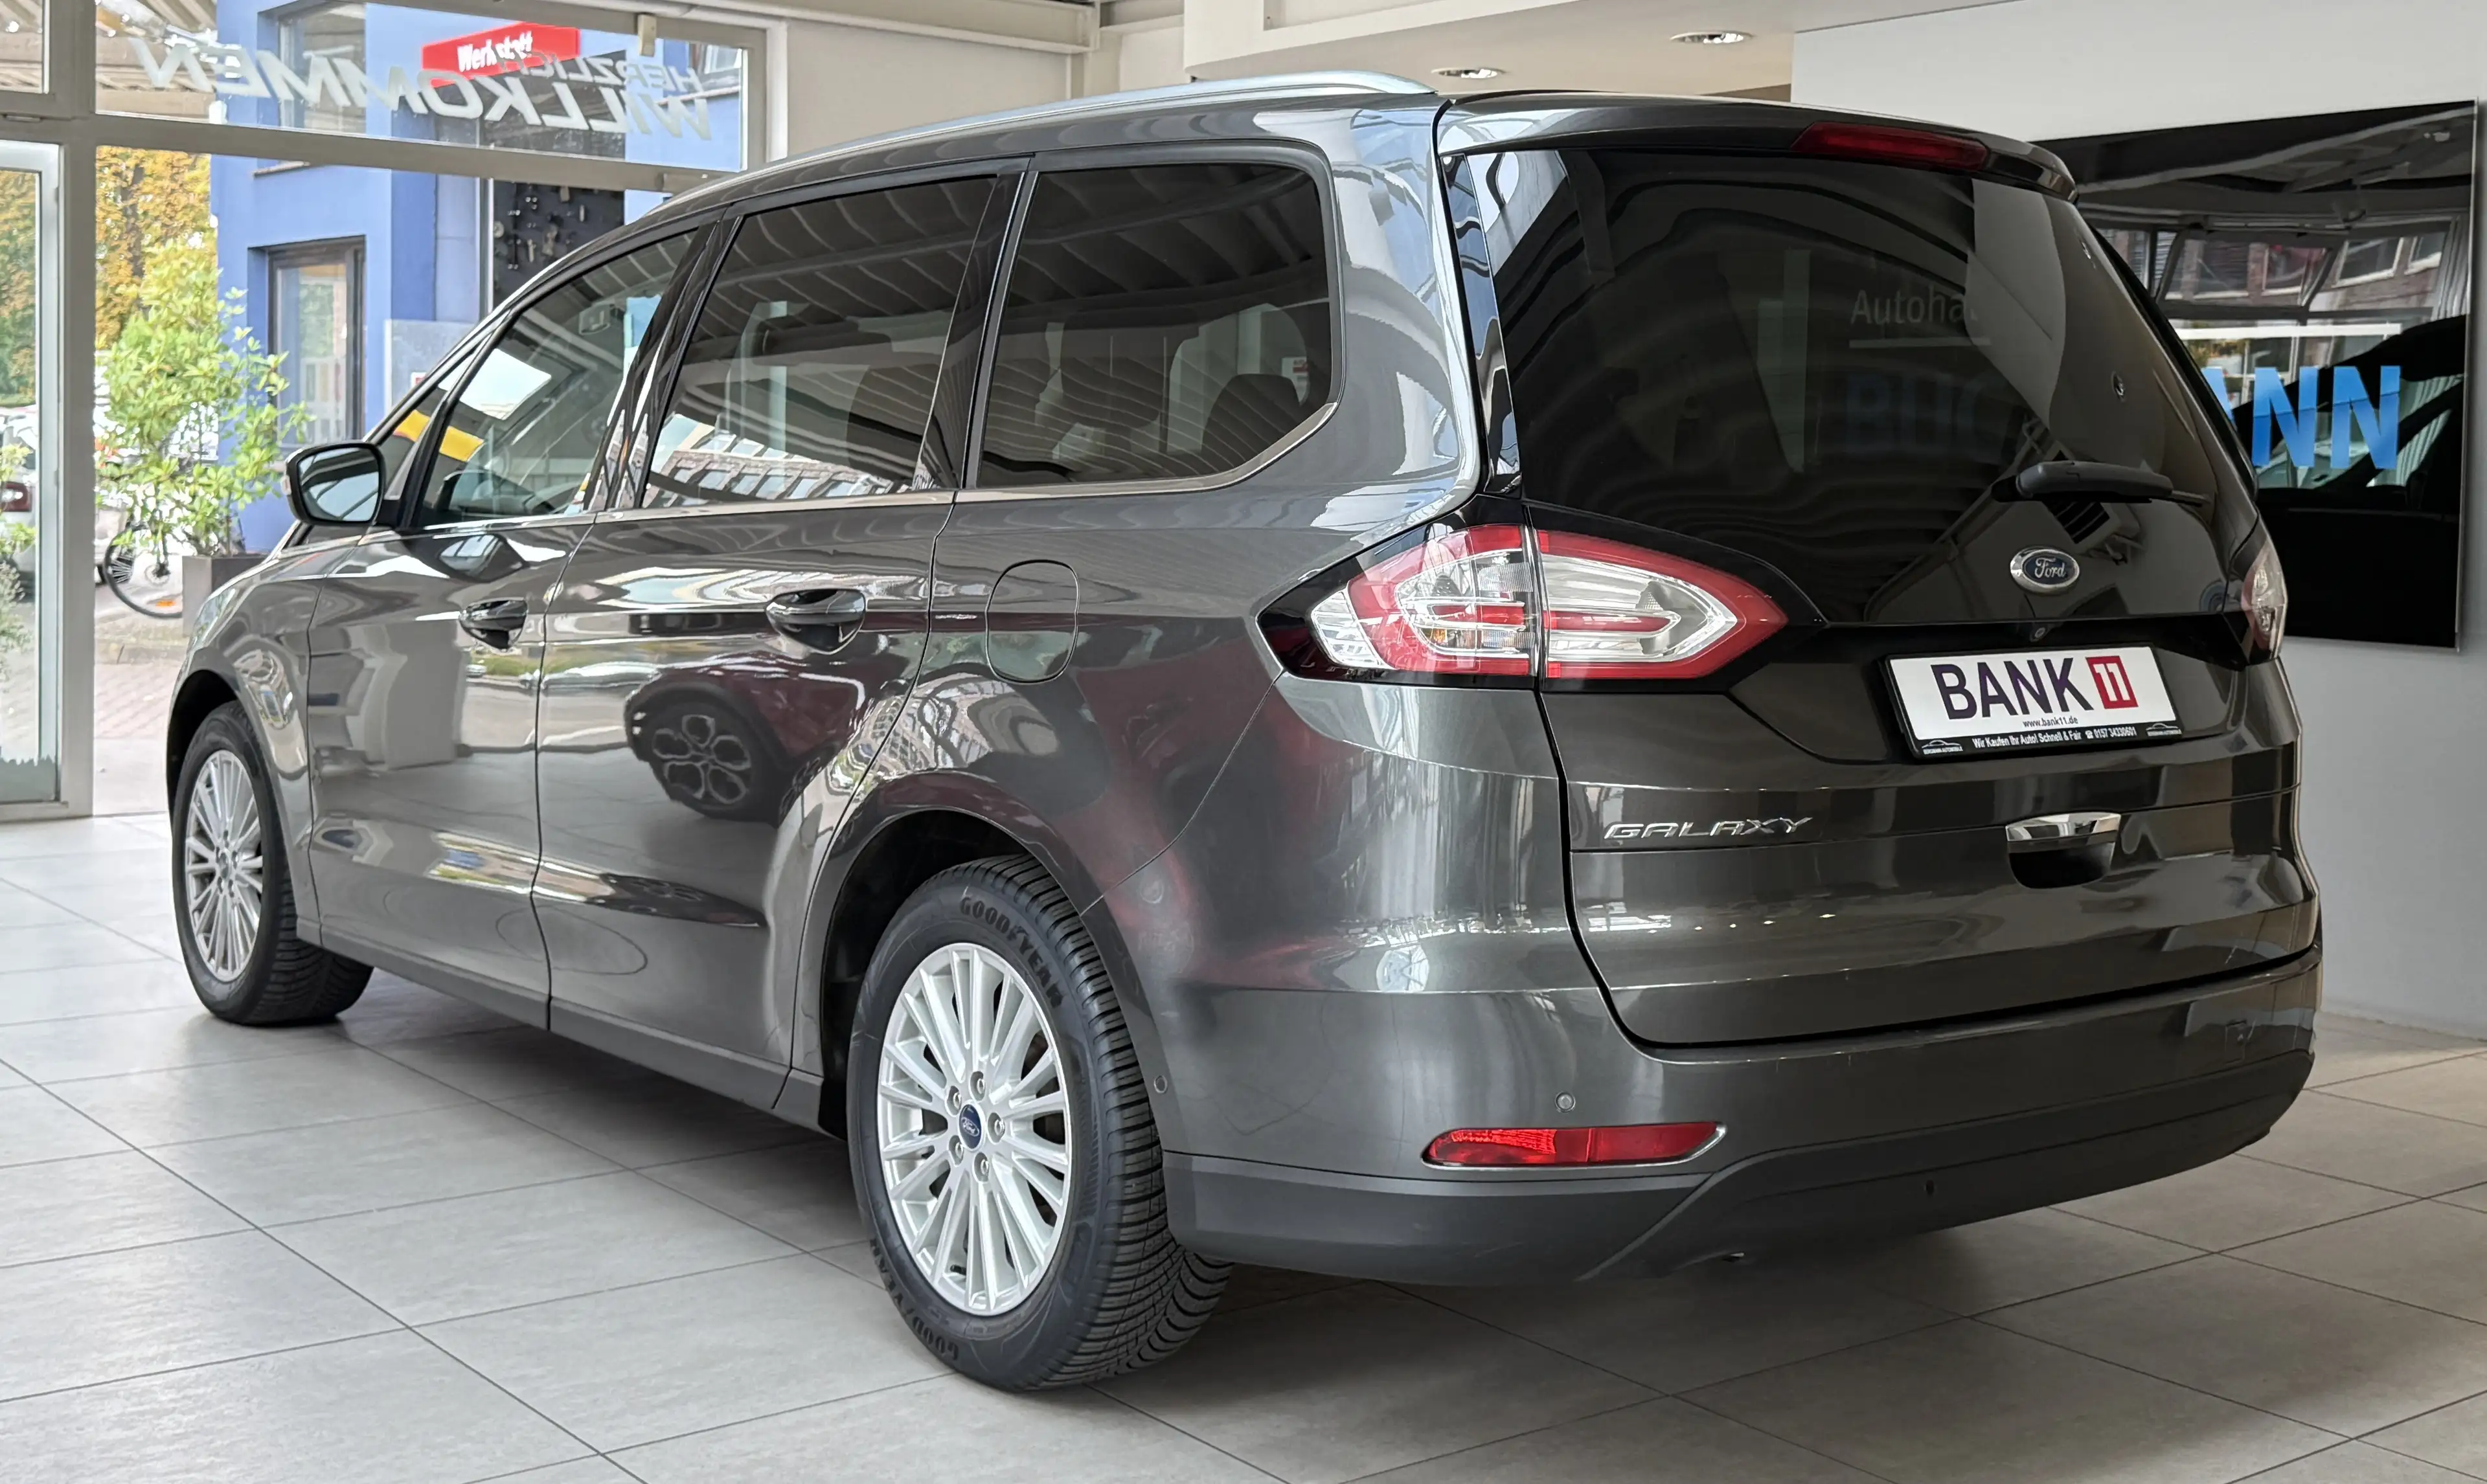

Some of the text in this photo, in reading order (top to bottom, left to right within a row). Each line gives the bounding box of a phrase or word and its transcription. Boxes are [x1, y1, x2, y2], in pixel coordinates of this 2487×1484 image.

[2034, 557, 2067, 578] Ford
[1930, 657, 2133, 720] BANK 11
[2022, 716, 2078, 728] www.bank11.de
[1972, 737, 1985, 748] Wir
[1986, 736, 2009, 748] Kaufen
[2010, 735, 2019, 746] Ihr
[2020, 733, 2038, 745] Auto!
[2039, 730, 2064, 743] Schnell
[2070, 730, 2082, 741] Fair
[1604, 816, 1813, 840] GALAXY
